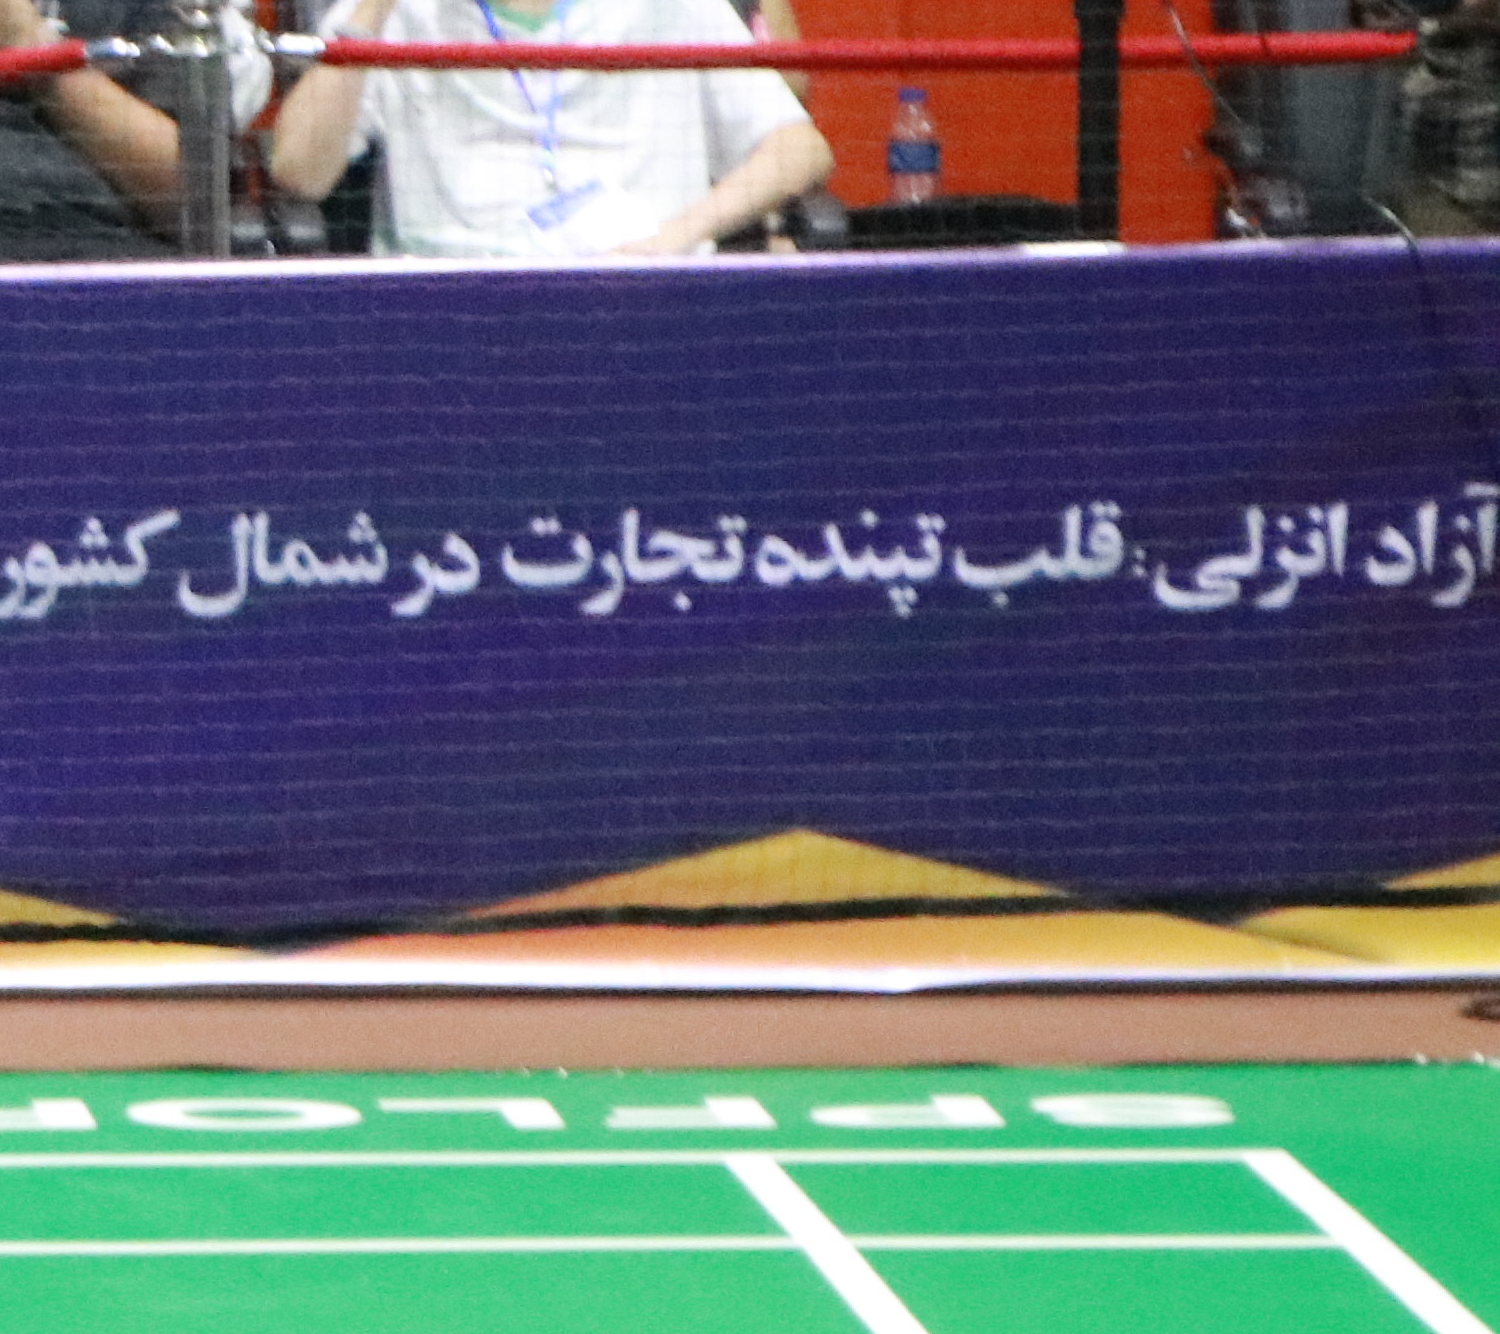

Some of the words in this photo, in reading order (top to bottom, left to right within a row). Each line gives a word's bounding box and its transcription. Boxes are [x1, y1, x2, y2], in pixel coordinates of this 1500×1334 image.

[177, 509, 389, 619] شمال
[390, 531, 481, 618] در
[501, 507, 746, 615] تجارت
[755, 511, 948, 617] تپنده
[954, 499, 1125, 611] قلب
[1366, 481, 1500, 609] آزاد
